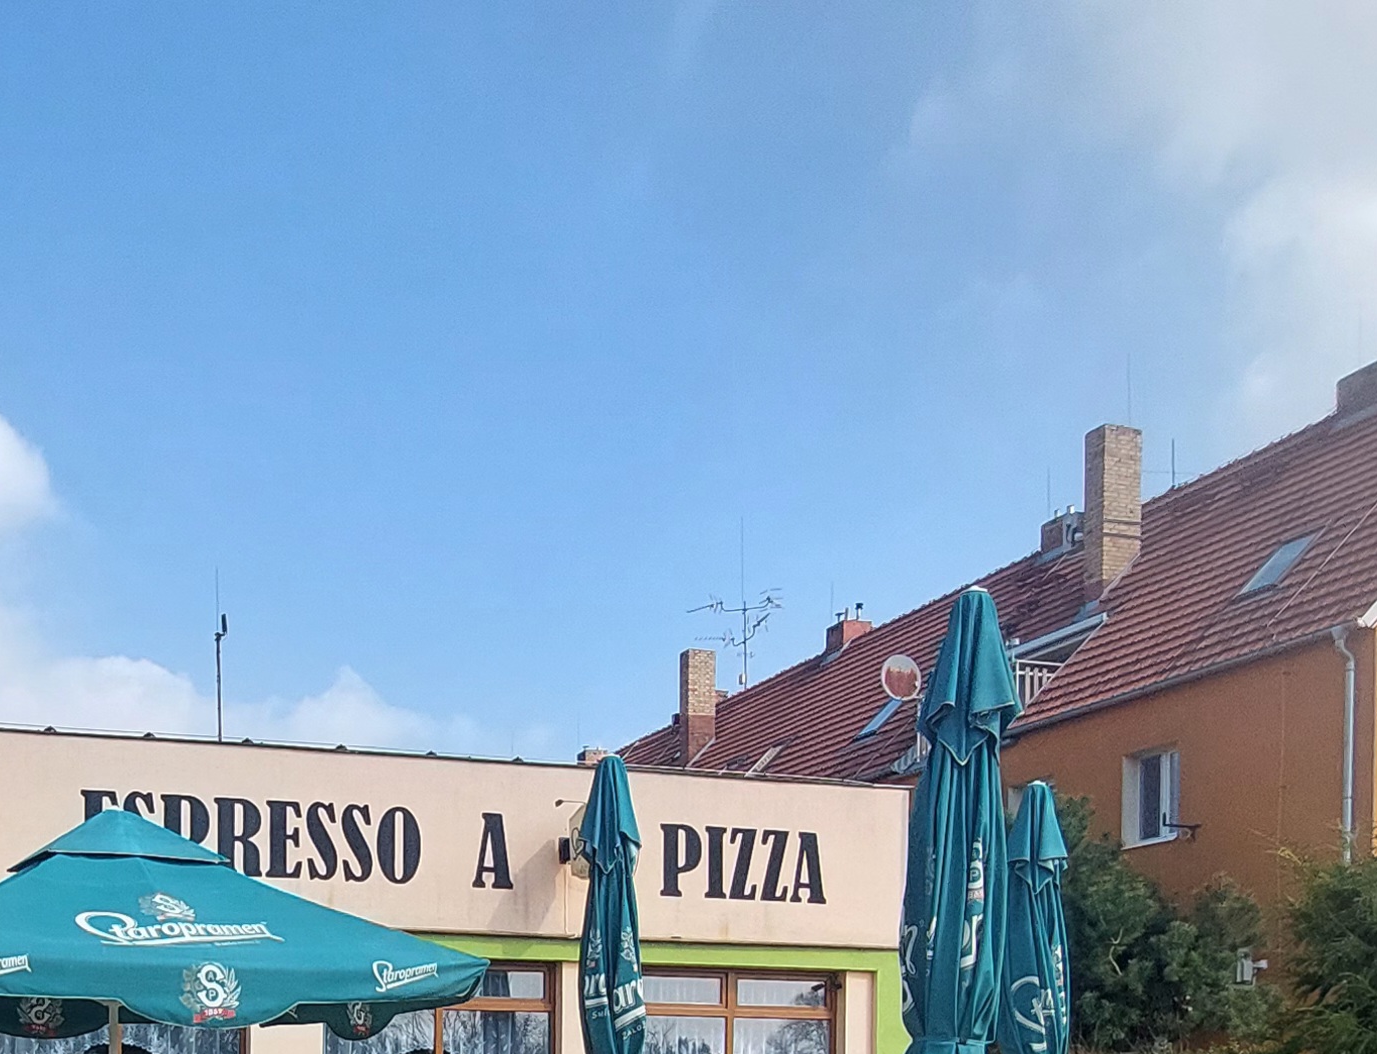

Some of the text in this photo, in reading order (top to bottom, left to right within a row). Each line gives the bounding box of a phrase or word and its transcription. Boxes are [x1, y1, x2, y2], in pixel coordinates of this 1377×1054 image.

[80, 789, 421, 884] PRESSO
[472, 812, 513, 890] A
[659, 823, 826, 905] PIZZA
[74, 911, 285, 947] Staropramen
[372, 960, 439, 993] Staropramen
